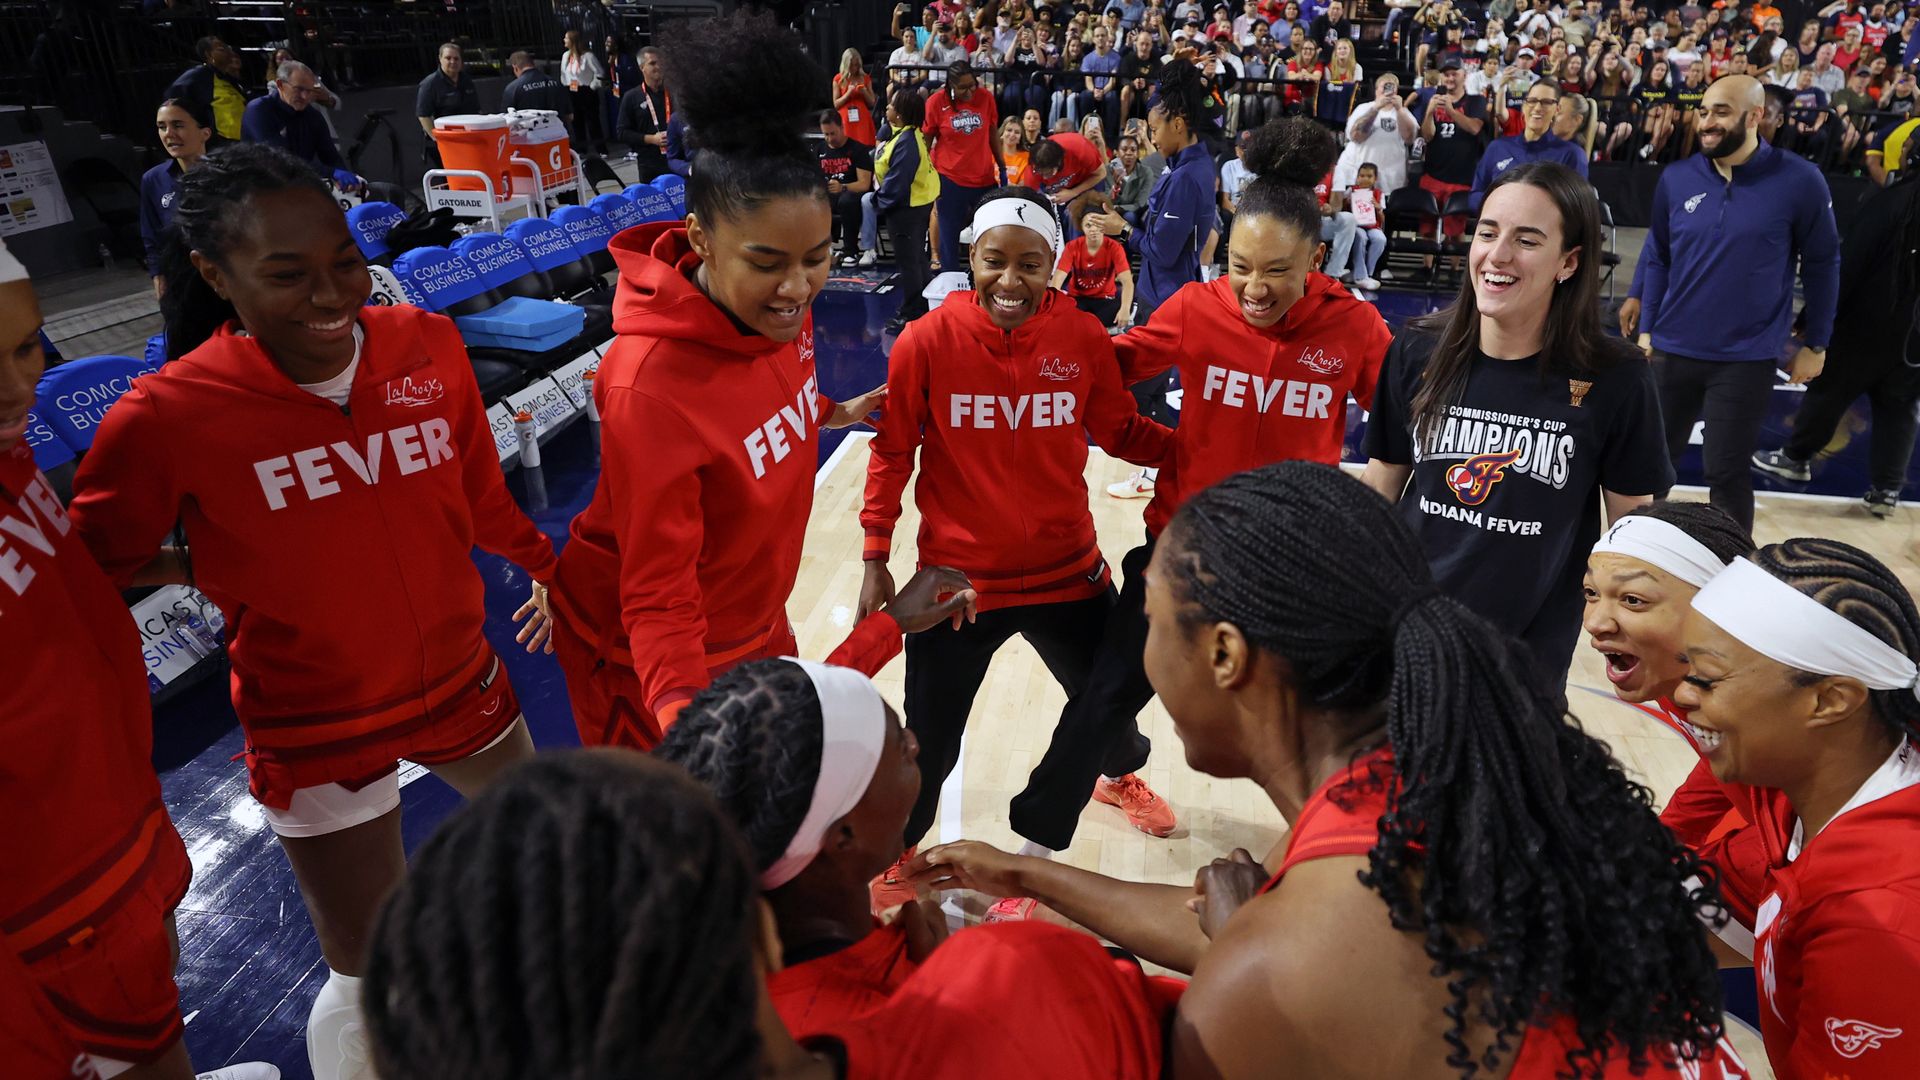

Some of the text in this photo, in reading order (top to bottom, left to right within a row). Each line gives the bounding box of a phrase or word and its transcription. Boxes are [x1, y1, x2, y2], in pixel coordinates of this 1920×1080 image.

[1440, 122, 1455, 135] 22
[549, 144, 562, 171] G
[437, 198, 482, 208] GATORADE
[637, 193, 666, 208] COMCAS
[666, 183, 685, 197] COMCA
[356, 210, 408, 232] COMCAST
[564, 216, 604, 233] COMCAST
[606, 201, 635, 221] COMCAS
[522, 228, 567, 248] COMCAST
[570, 225, 611, 243] BUSINESS
[468, 238, 517, 262] COMCAST
[476, 248, 525, 274] BUSINESS
[413, 255, 468, 281] COMCAST
[422, 267, 477, 294] BUSINESS
[1039, 357, 1080, 381] LaCroix
[1297, 346, 1344, 375] LaCroix
[561, 359, 600, 391] COMCST
[384, 376, 444, 408] LaCroix
[516, 386, 562, 416] COMCAST
[1202, 364, 1334, 420] FEVER
[532, 399, 572, 429] USINESS
[743, 368, 820, 480] FEVE
[950, 391, 1077, 431] FEVER
[1449, 405, 1541, 429] COMMISSIONER'S
[1543, 420, 1567, 433] CUP
[253, 417, 455, 512] FEVER
[1419, 494, 1543, 536] NDIANA FEVER
[0, 469, 72, 597] EVE
